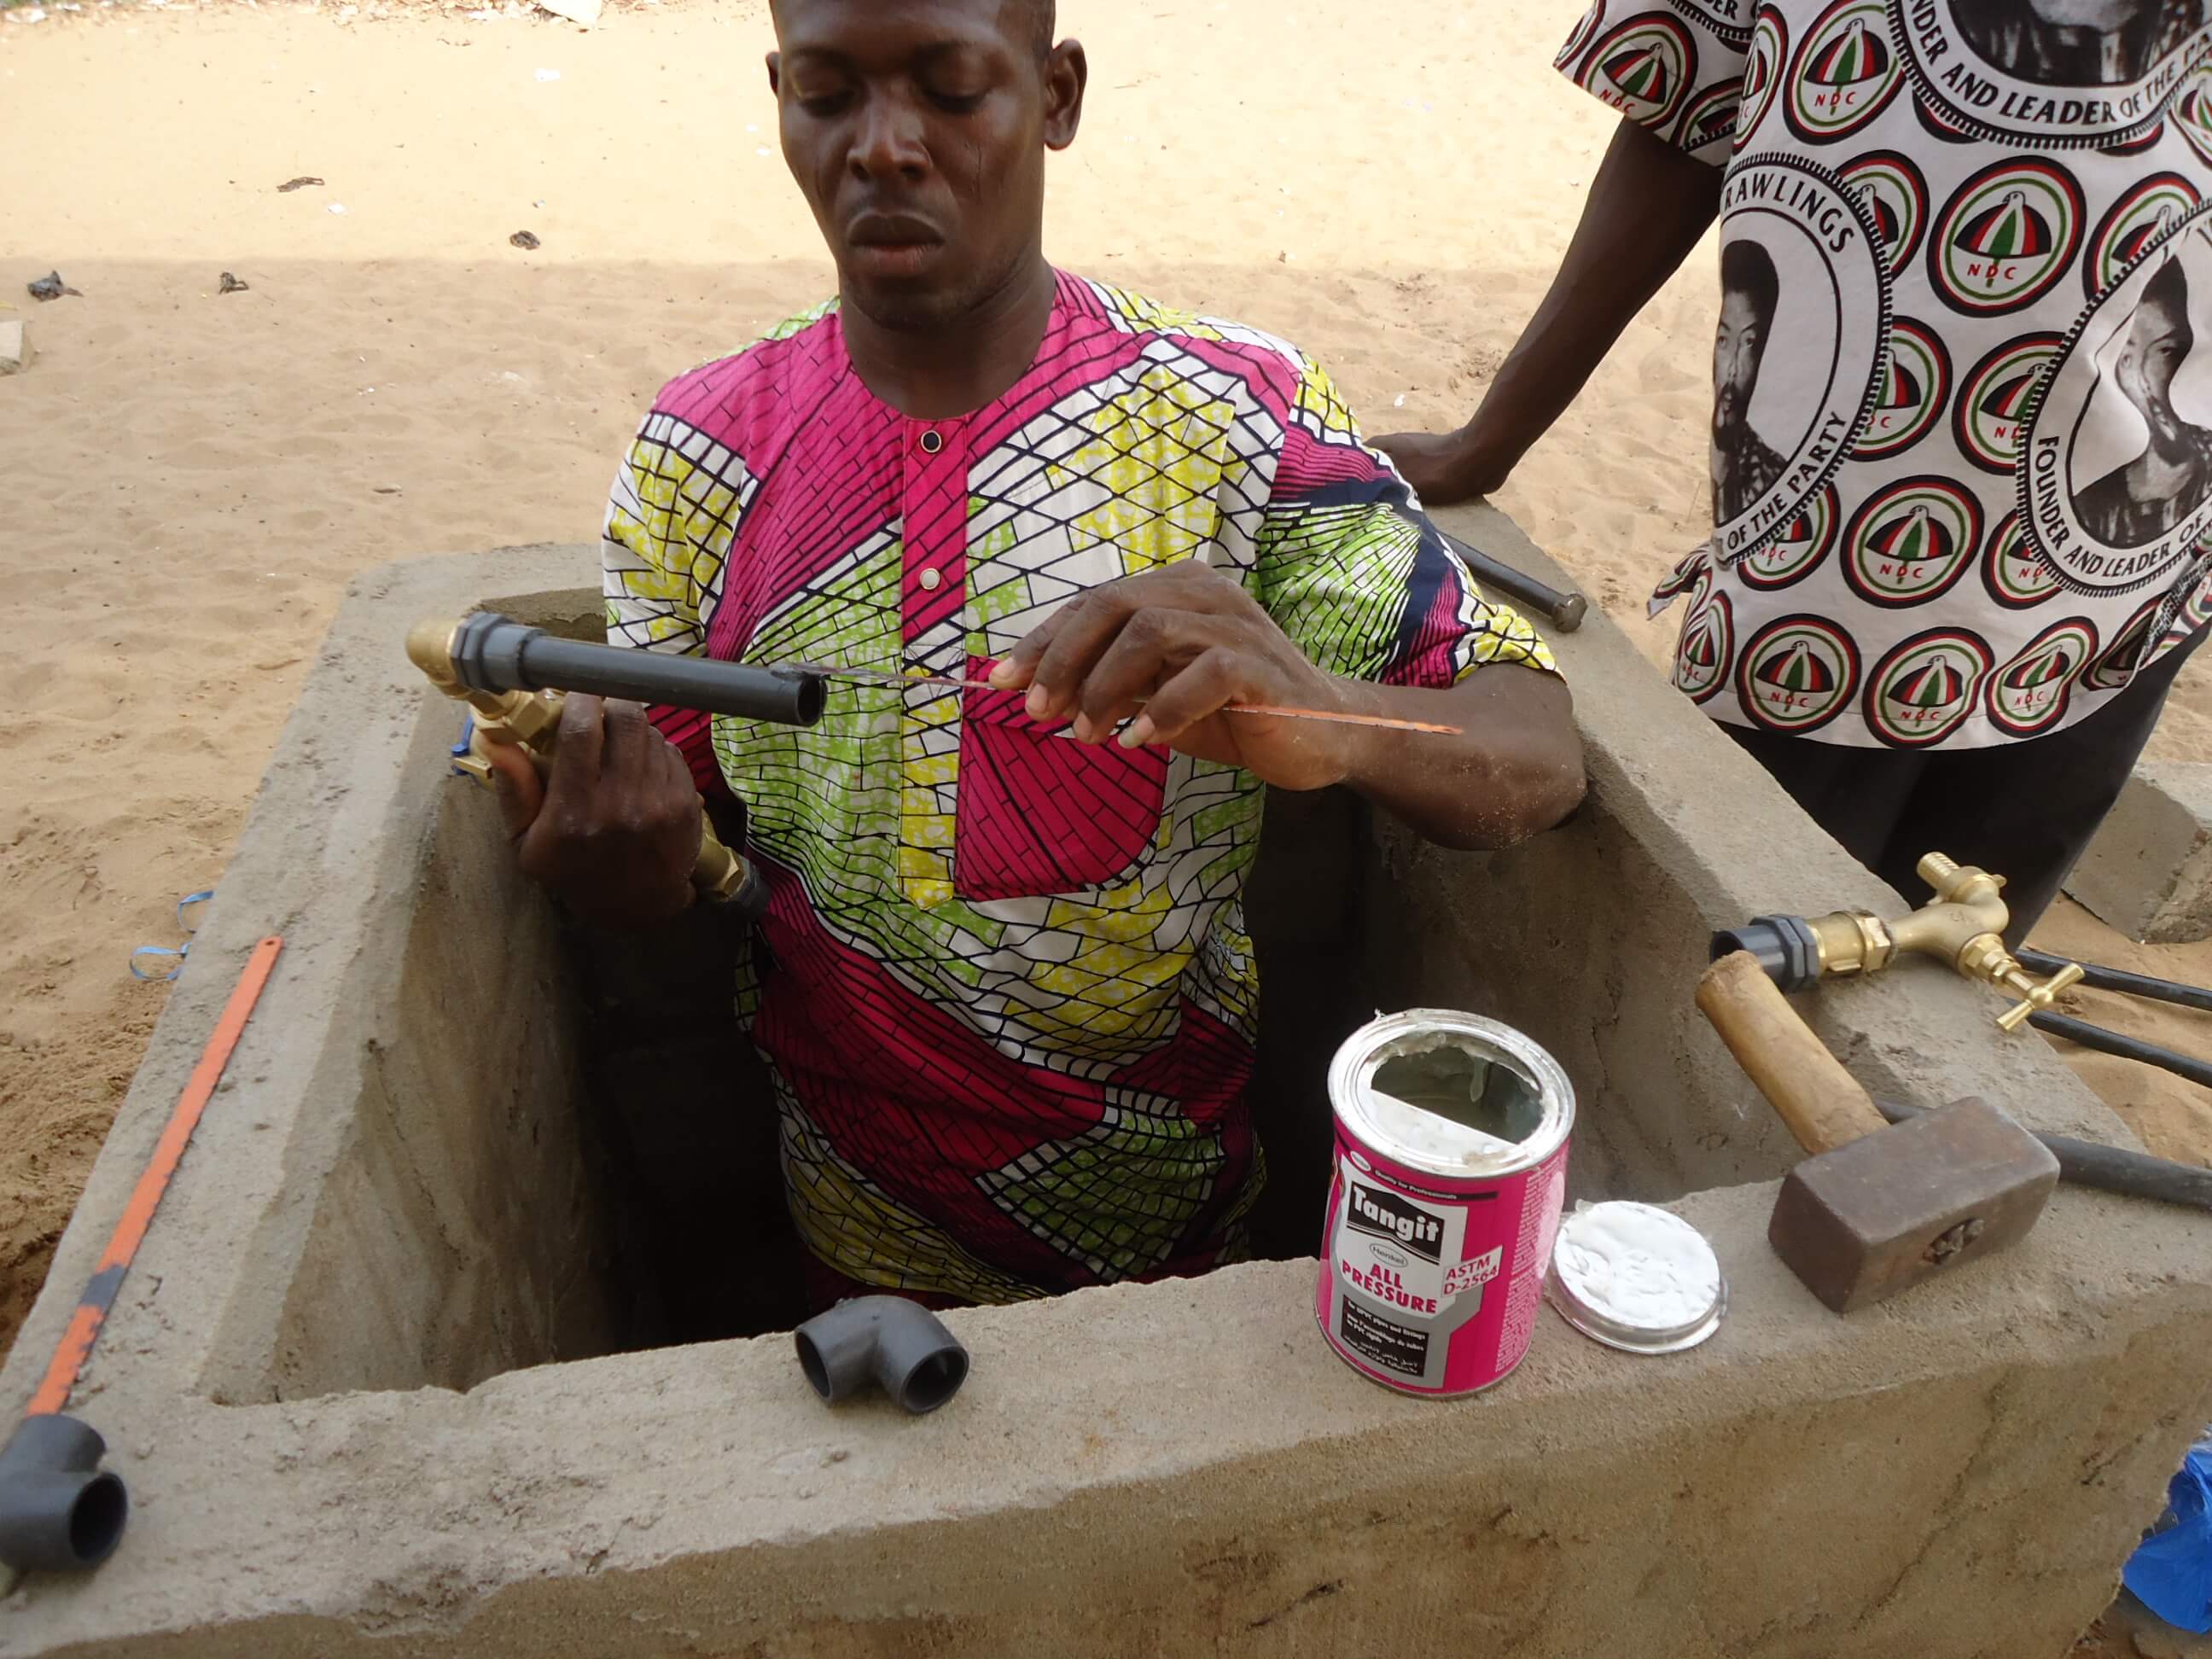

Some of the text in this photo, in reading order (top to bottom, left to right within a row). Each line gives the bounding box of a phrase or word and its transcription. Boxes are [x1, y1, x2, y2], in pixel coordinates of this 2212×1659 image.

[1708, 0, 1738, 20] ER
[1598, 88, 1636, 114] NDC
[1814, 91, 1856, 107] NDC
[1941, 62, 1999, 108] AND
[2000, 91, 2116, 125] LEADER
[2119, 91, 2140, 118] OF
[2145, 61, 2175, 102] THE
[1724, 172, 1854, 253] RAWLINGS
[1966, 263, 2017, 281] NDC
[1994, 426, 2021, 439] ND
[1728, 410, 1847, 550] OF THE PARTY
[2035, 435, 2203, 578] FOUNDER AND LEADER OF
[1879, 563, 1924, 579] NDC
[2018, 567, 2043, 578] ND
[1769, 690, 1809, 708] NDC
[2014, 690, 2046, 706] NDC
[1900, 709, 1940, 721] NDC
[1353, 1185, 1440, 1243] Tangit
[1370, 1263, 1404, 1289] ALL
[1443, 1265, 1499, 1296] D-2564
[1446, 1254, 1491, 1281] ASTM
[1342, 1259, 1438, 1314] PRESSURE
